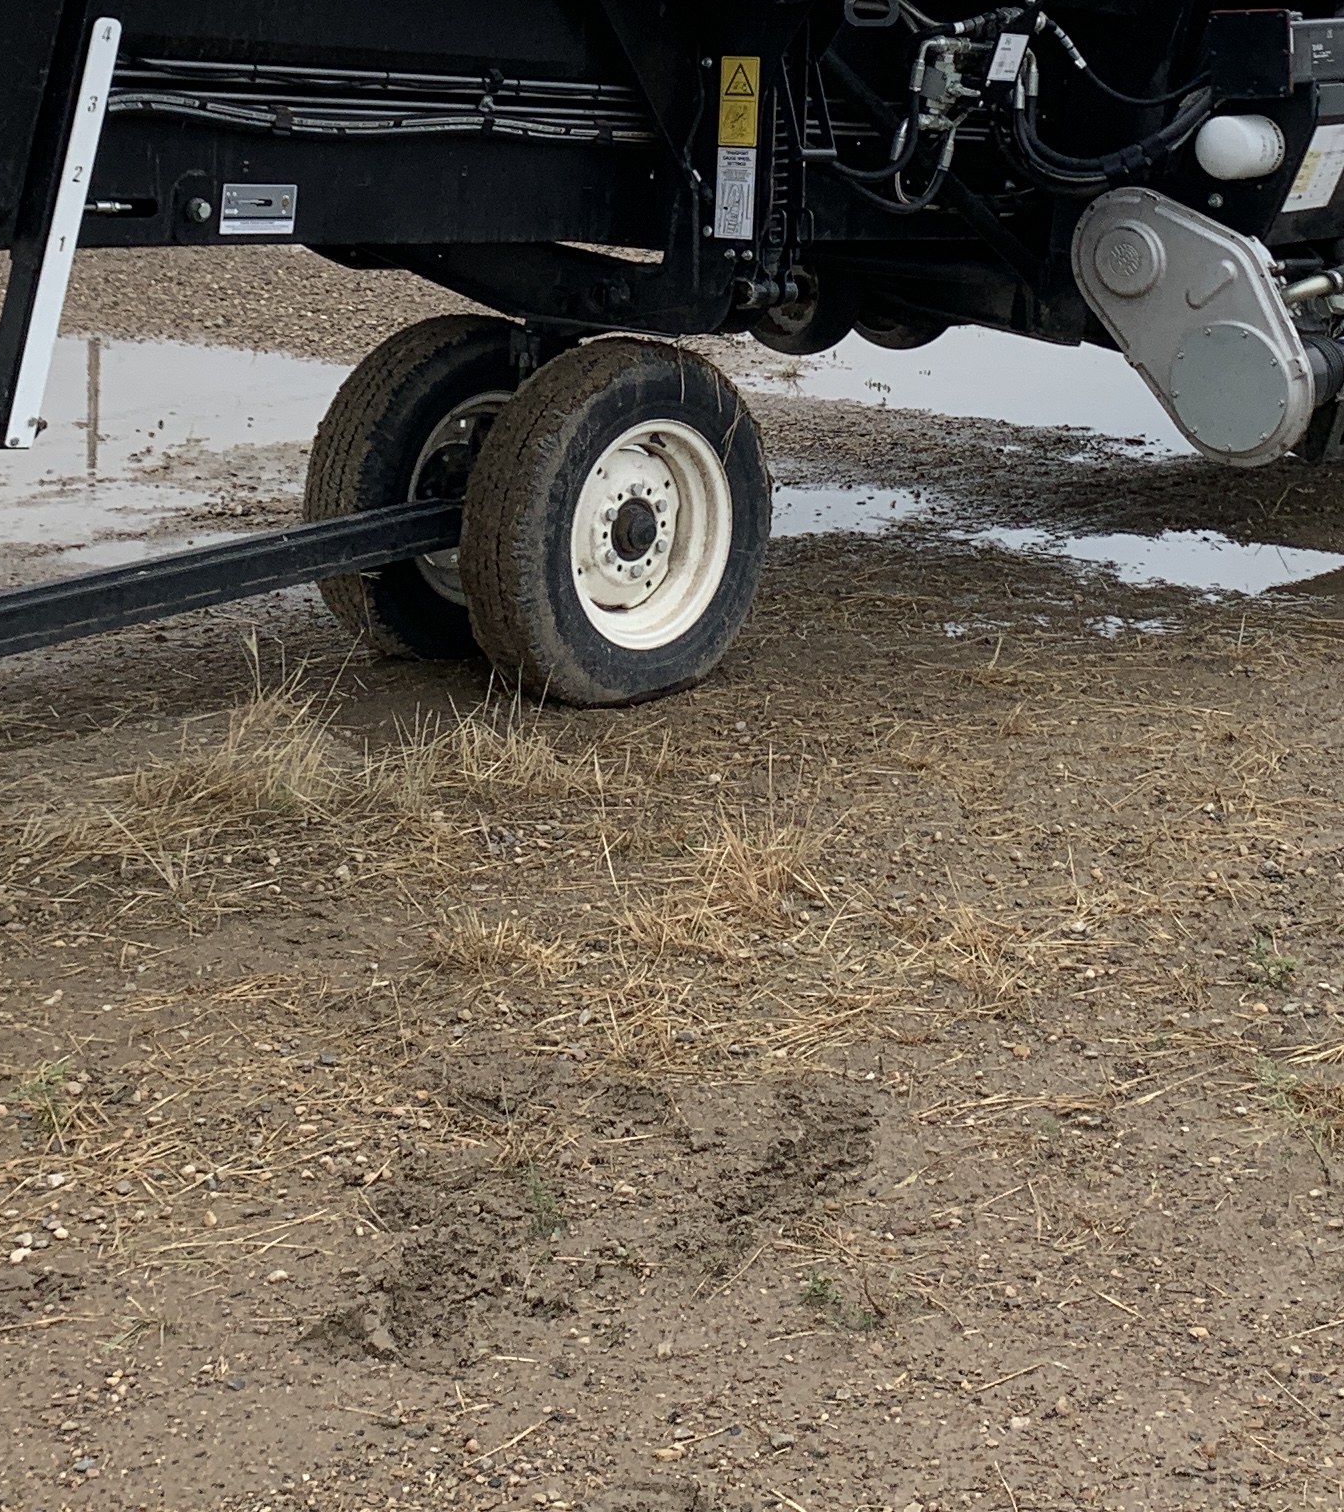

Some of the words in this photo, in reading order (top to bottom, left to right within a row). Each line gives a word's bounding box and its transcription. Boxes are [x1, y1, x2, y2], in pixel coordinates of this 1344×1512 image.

[101, 26, 112, 42] 4
[87, 95, 98, 113] 3
[72, 166, 84, 183] 2
[58, 235, 66, 252] 1
